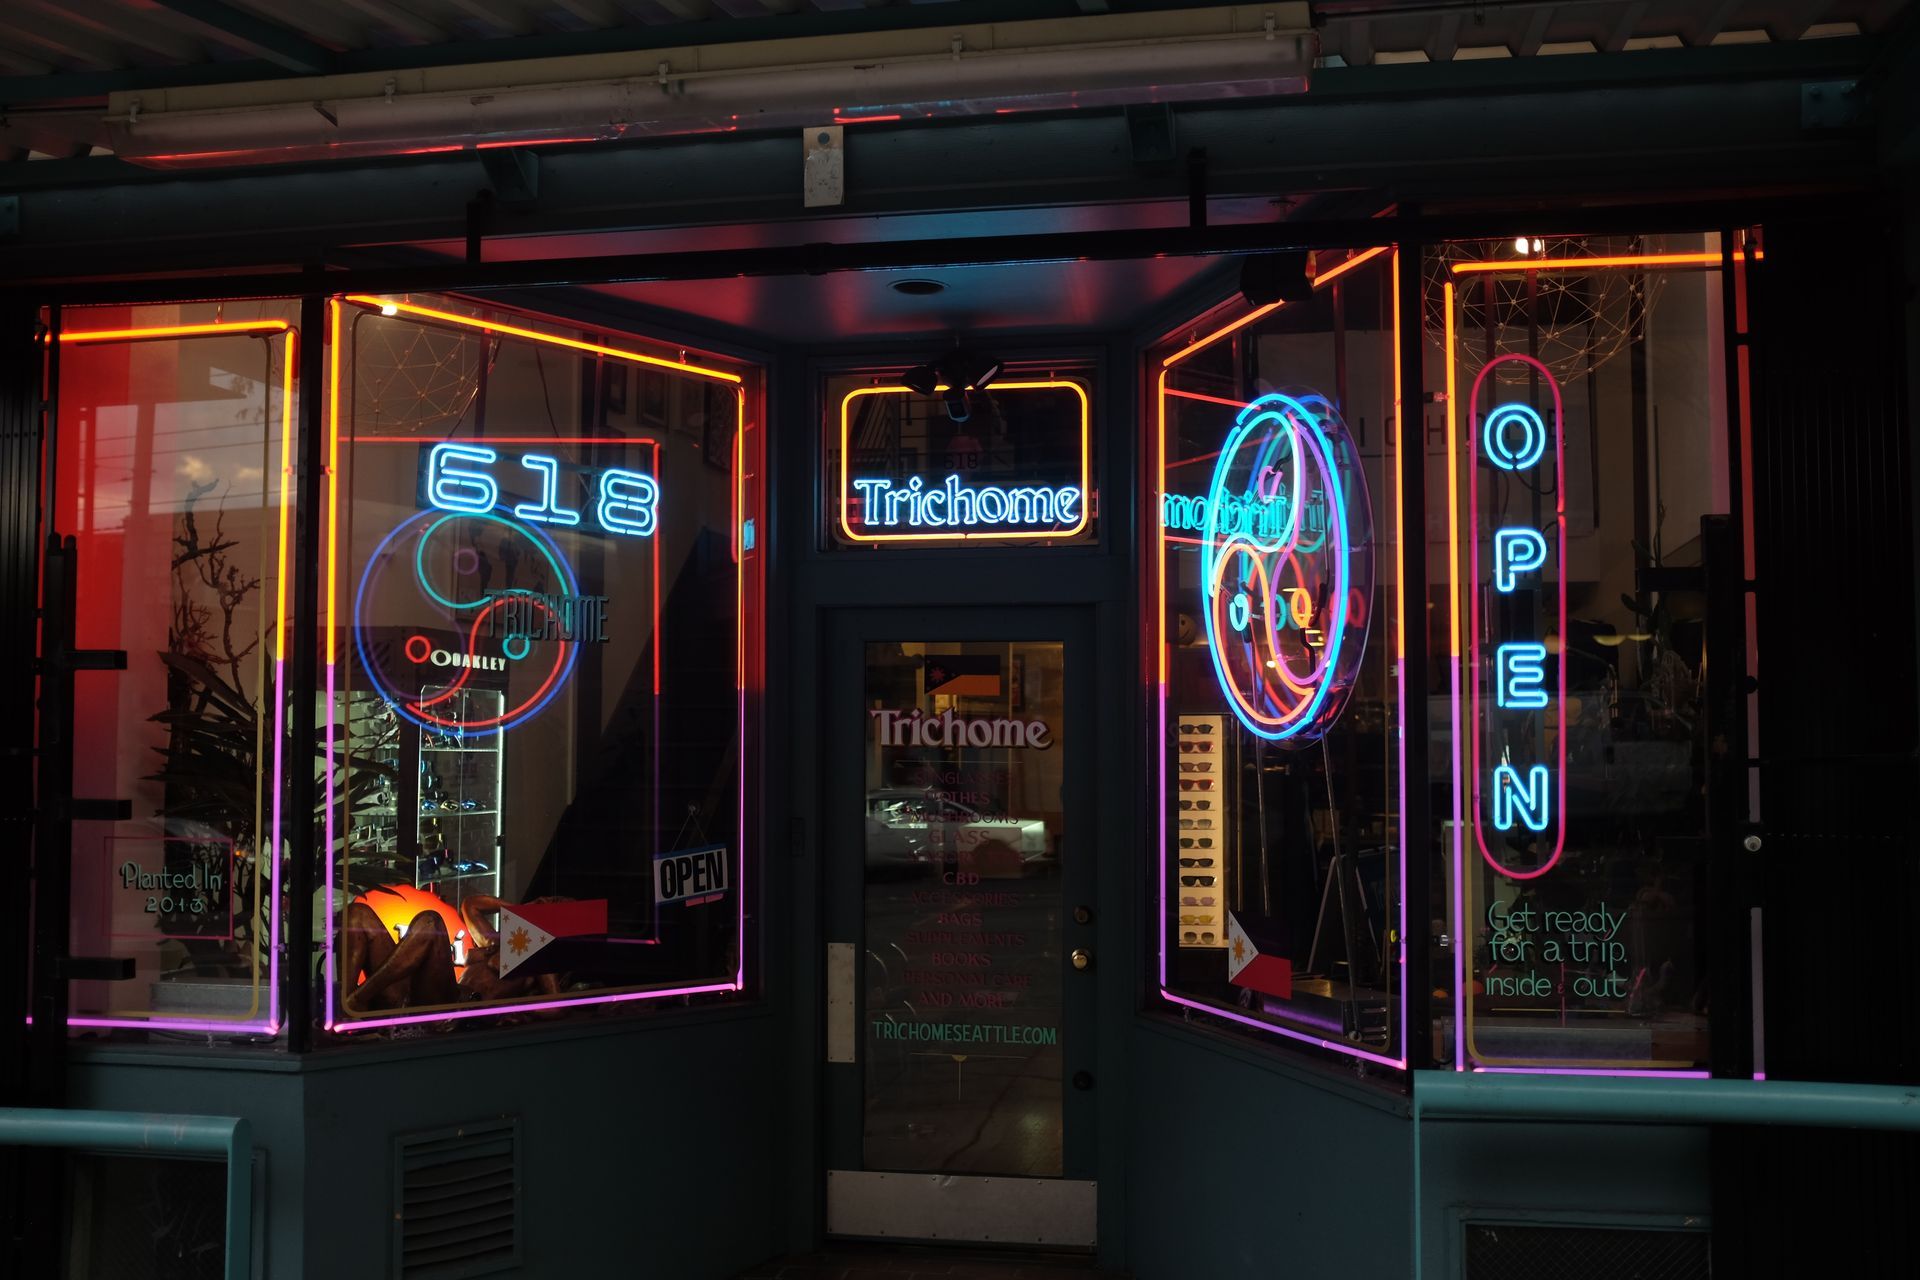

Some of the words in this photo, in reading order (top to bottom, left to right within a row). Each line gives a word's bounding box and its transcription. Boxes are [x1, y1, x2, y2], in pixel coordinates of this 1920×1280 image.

[428, 442, 660, 537] 618
[853, 474, 1081, 526] Trichome
[1483, 403, 1550, 831] OPEN
[869, 706, 1055, 750] Trichome
[120, 861, 199, 889] Planted
[204, 862, 222, 890] In
[660, 850, 724, 899] OPEN
[943, 871, 980, 885] CBD
[940, 911, 983, 927] BAGS
[1487, 900, 1540, 932] Get
[1545, 901, 1628, 942] ready
[931, 952, 992, 967] BOOKS
[1488, 931, 1535, 962] for
[1543, 941, 1565, 962] a
[1485, 969, 1552, 997] inside
[1573, 970, 1628, 998] out
[919, 991, 952, 1007] AND
[872, 1020, 1057, 1045] TRICHOMESEATTLE.COM
